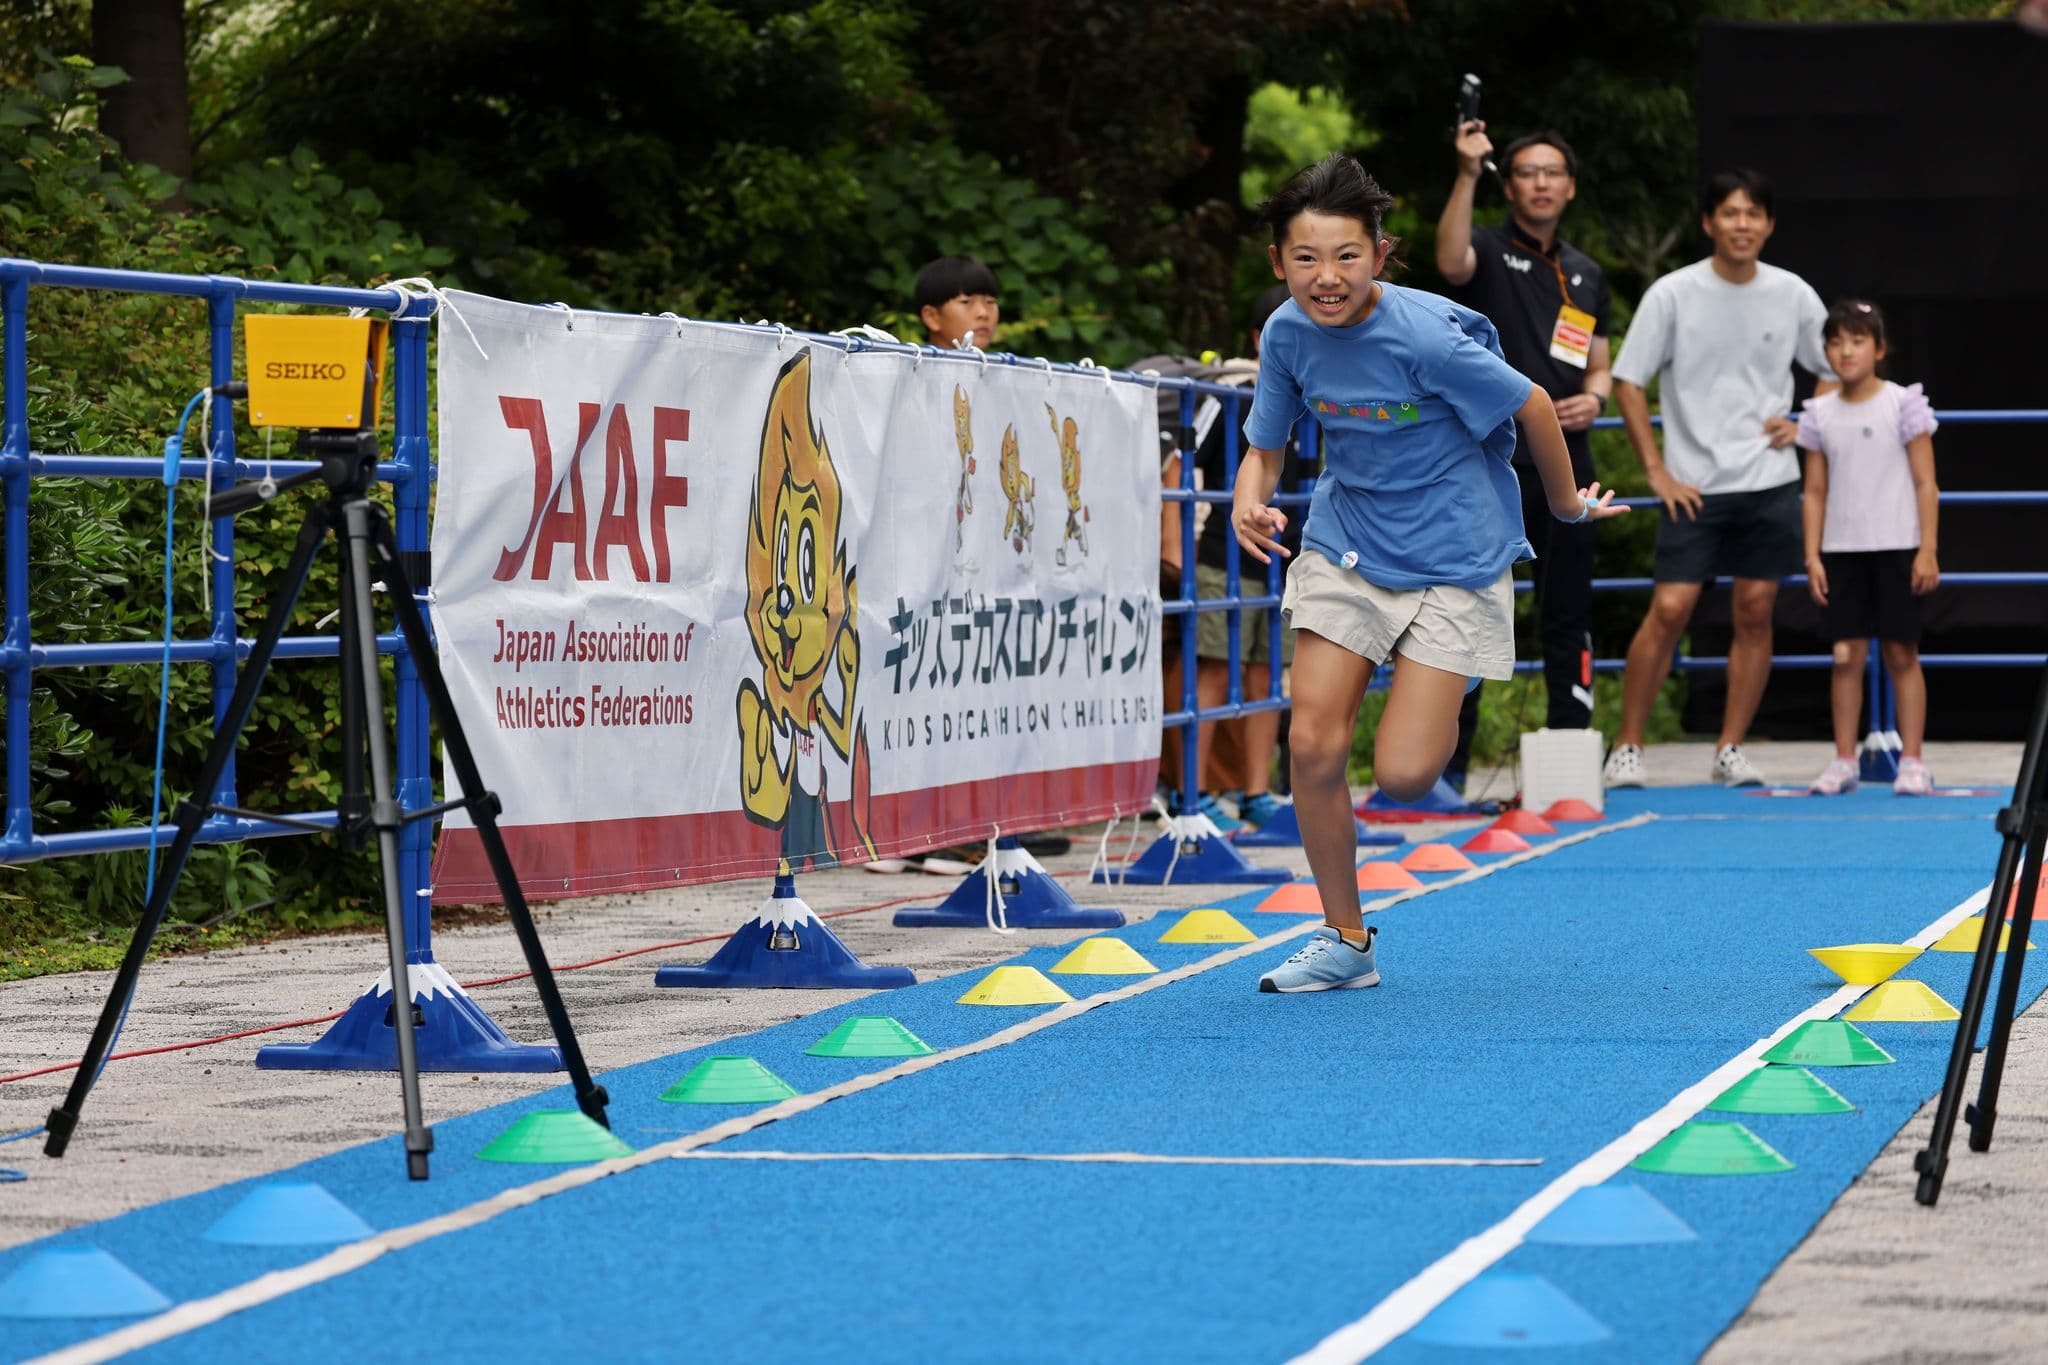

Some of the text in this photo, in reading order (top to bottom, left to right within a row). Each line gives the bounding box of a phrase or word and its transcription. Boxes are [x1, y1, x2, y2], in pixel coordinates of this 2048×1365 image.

[266, 362, 346, 380] SEIKO
[492, 395, 690, 583] JAAF
[494, 619, 695, 672] Japan Association of
[496, 684, 693, 729] Athletics Federations
[884, 714, 932, 750] KIDS
[1061, 696, 1155, 729] CHLLEG
